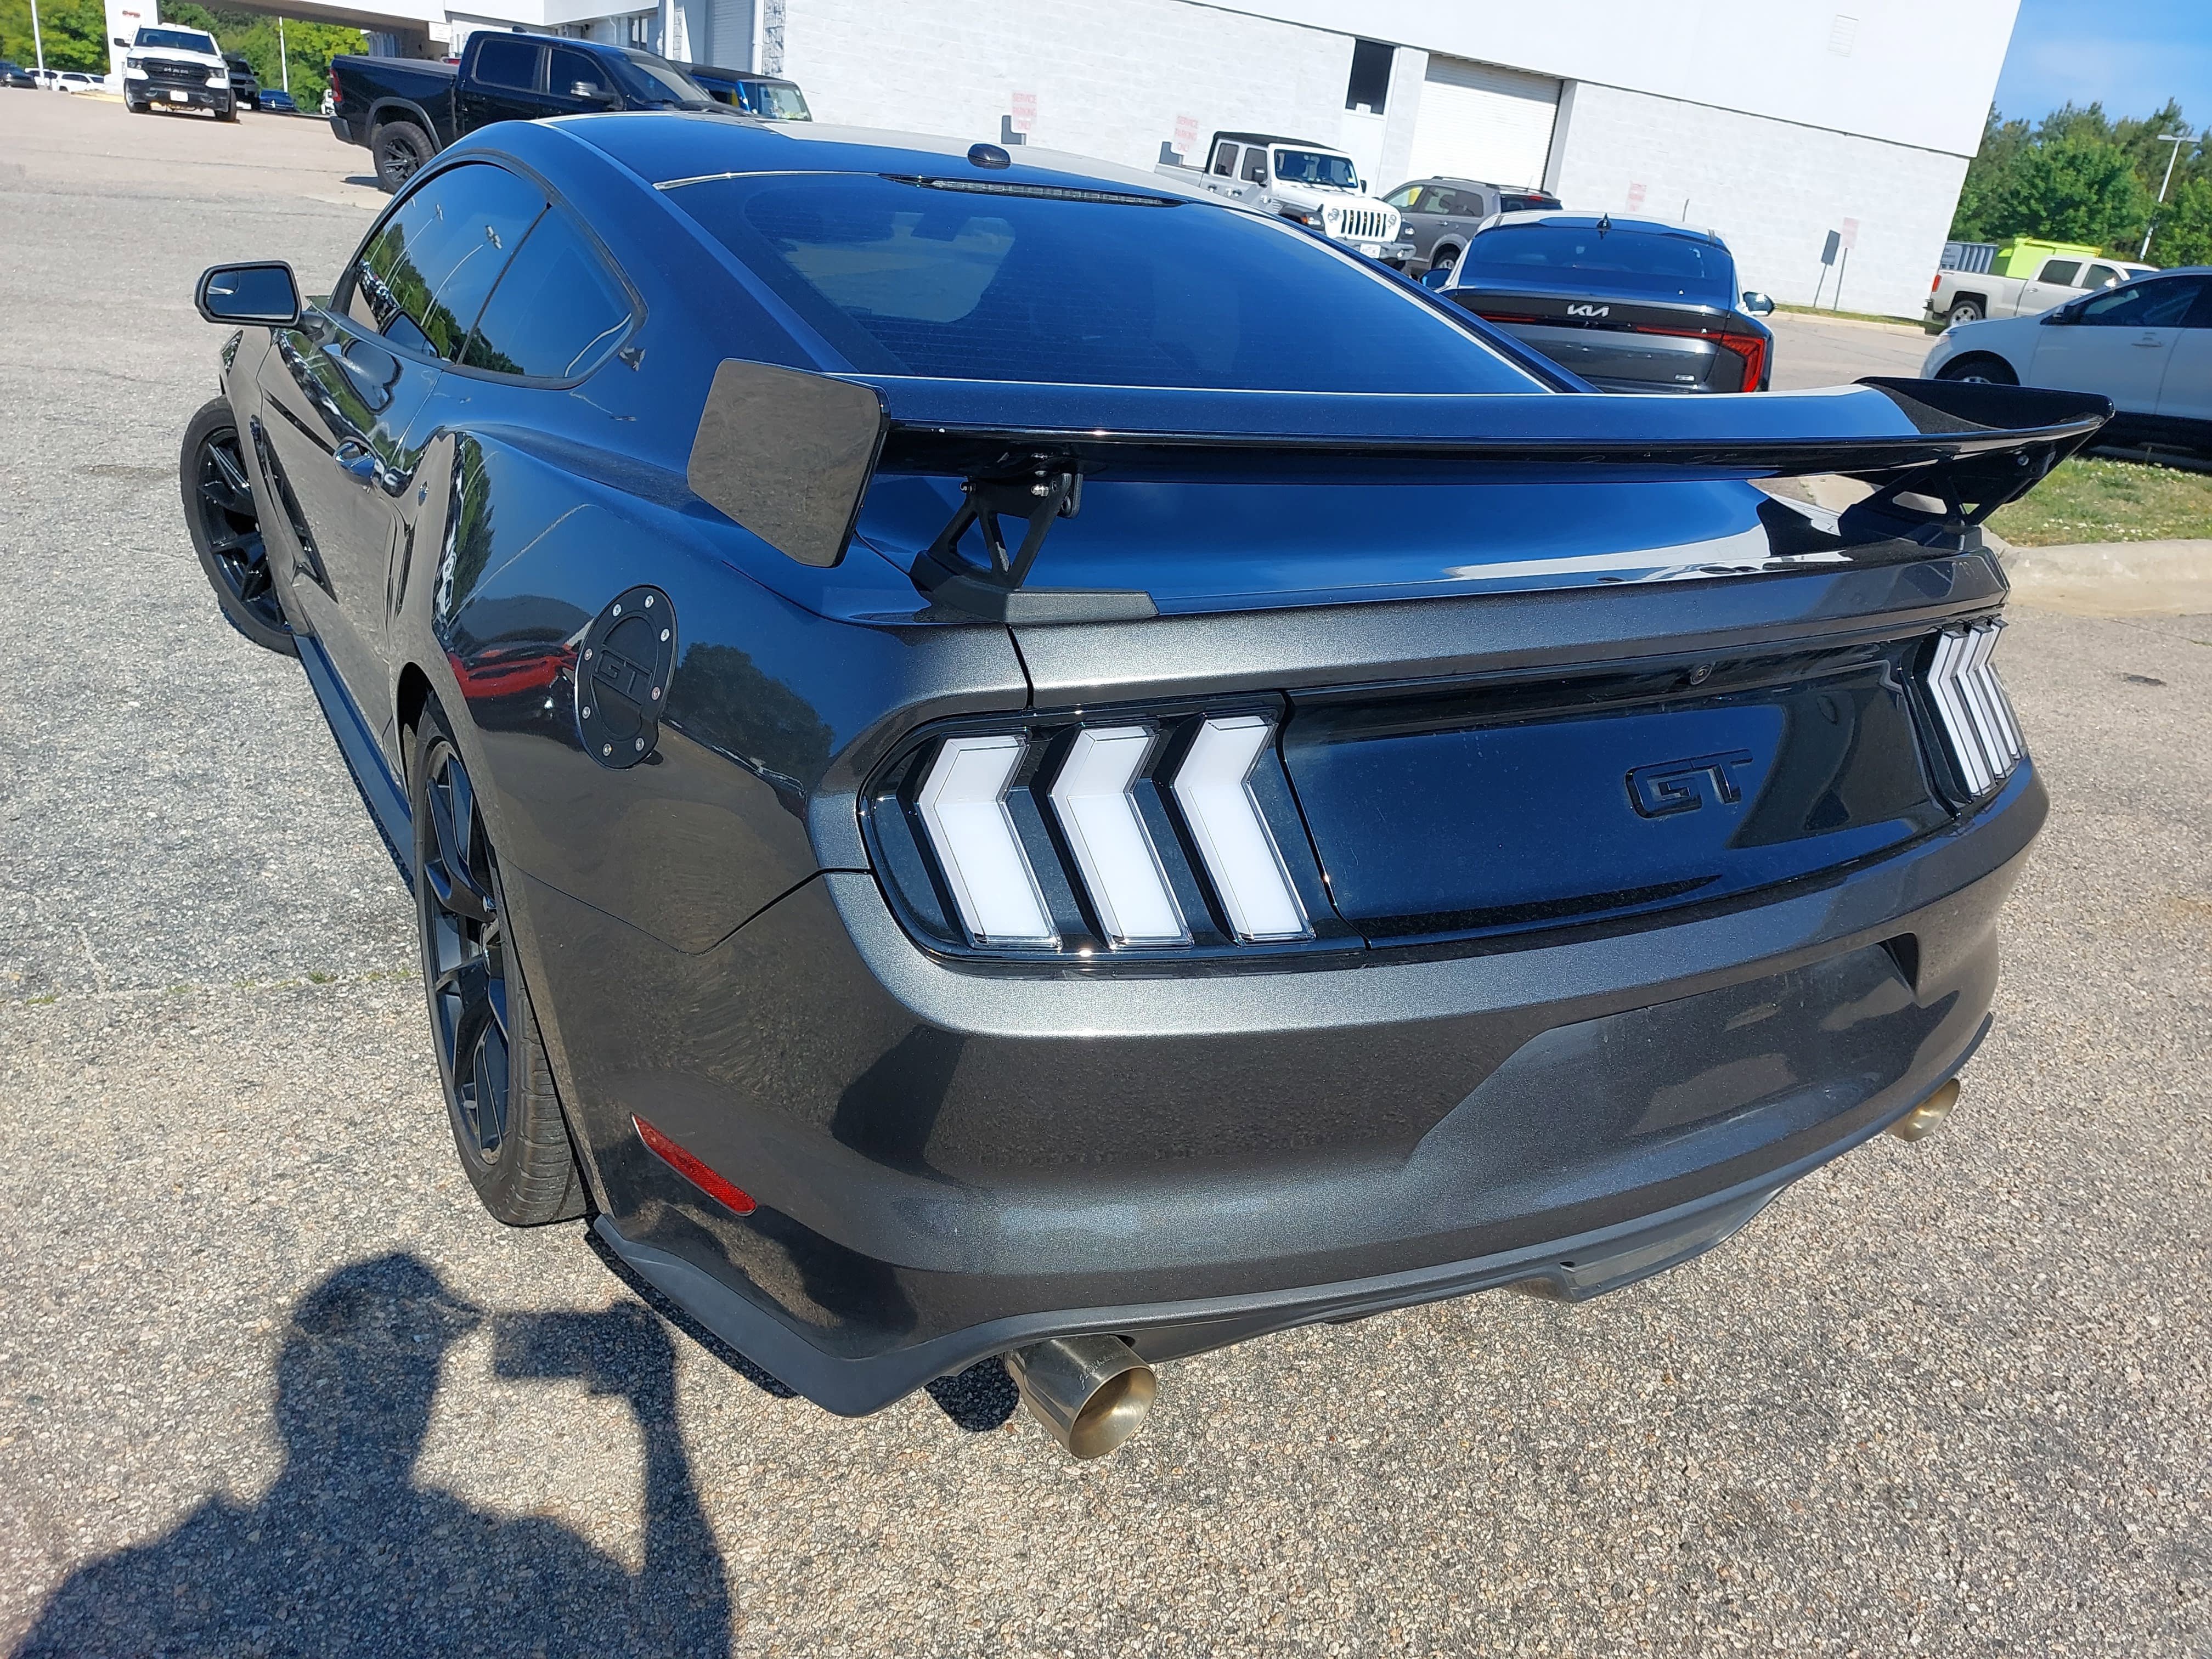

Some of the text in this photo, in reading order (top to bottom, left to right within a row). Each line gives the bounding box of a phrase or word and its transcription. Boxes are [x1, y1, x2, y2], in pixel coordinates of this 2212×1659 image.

[1567, 303, 1610, 318] KIA
[594, 644, 653, 703] GT
[1624, 748, 1754, 820] GT
